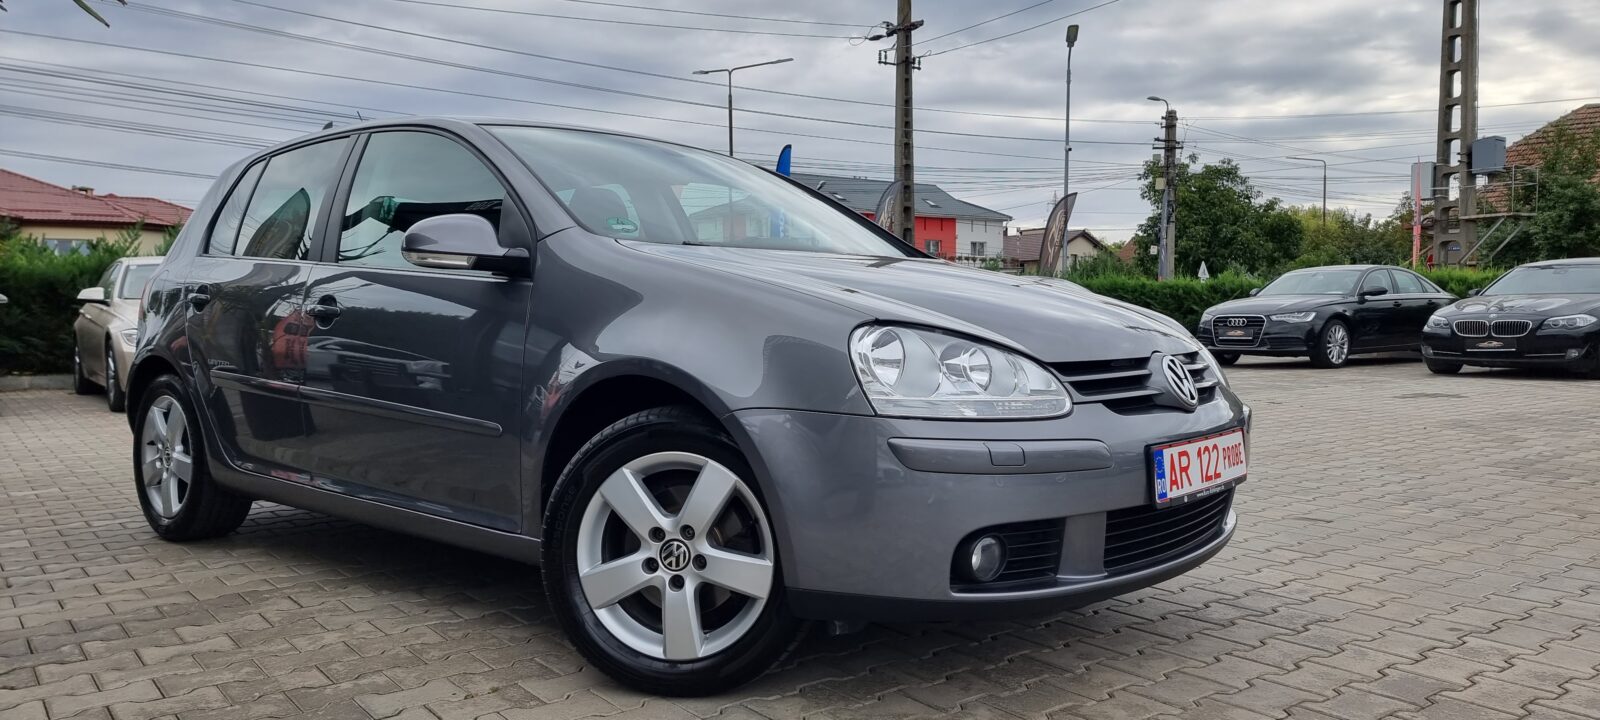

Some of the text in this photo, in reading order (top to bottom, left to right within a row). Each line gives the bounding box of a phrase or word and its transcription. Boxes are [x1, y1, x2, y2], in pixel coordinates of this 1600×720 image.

[1169, 443, 1243, 492] AR 122 PROBE
[1157, 478, 1167, 495] RO
